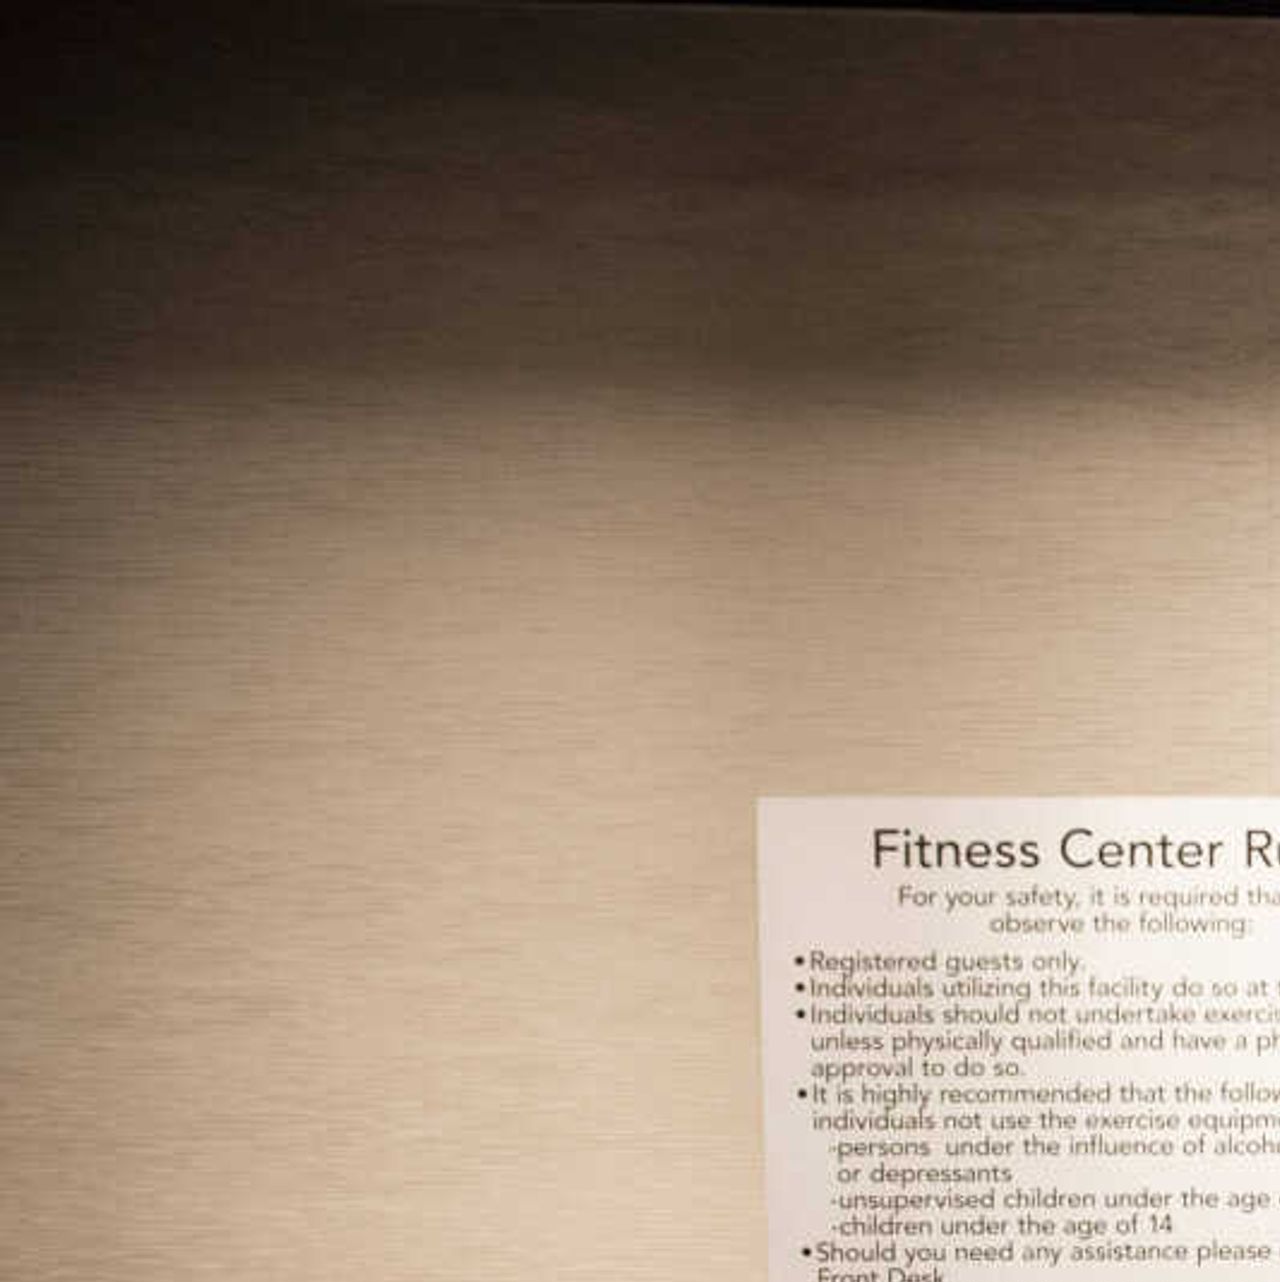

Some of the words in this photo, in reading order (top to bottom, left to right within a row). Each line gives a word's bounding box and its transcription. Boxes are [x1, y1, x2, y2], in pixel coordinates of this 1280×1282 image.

[872, 827, 1042, 868] Fitness
[1059, 827, 1225, 868] Center
[897, 883, 939, 906] For
[943, 890, 999, 911] your
[1005, 883, 1081, 911] safety,
[1089, 883, 1105, 906] it
[1113, 883, 1131, 906] is
[1138, 883, 1240, 911] required
[989, 909, 1085, 932] observe
[1093, 909, 1131, 932] the
[809, 948, 938, 976] Registered
[945, 948, 1024, 976] guests
[808, 974, 935, 998] Individuals
[942, 974, 1032, 1003] utilizing
[1038, 974, 1082, 998] this
[1087, 974, 1164, 1003] facility
[1171, 974, 1204, 998] do
[1211, 981, 1239, 998] so
[1245, 974, 1269, 998] at
[810, 1001, 936, 1024] Individuals
[941, 1001, 1021, 1024] should
[1027, 1001, 1067, 1024] not
[1075, 1001, 1197, 1024] undertake
[810, 1027, 885, 1050] unless
[891, 1027, 1004, 1055] physically
[1009, 1027, 1113, 1055] qualified
[1120, 1027, 1164, 1050] and
[1172, 1027, 1227, 1050] have
[1235, 1034, 1248, 1050] a
[810, 1053, 914, 1081] approval
[921, 1053, 946, 1076] to
[953, 1053, 986, 1076] do
[992, 1060, 1025, 1076] so.
[811, 1080, 829, 1103] It
[835, 1080, 855, 1103] is
[860, 1080, 934, 1108] highly
[938, 1080, 1113, 1103] recommended
[1118, 1080, 1168, 1103] that
[1173, 1080, 1213, 1103] the
[812, 1106, 937, 1129] individuals
[942, 1106, 983, 1129] not
[990, 1113, 1032, 1129] use
[1037, 1106, 1077, 1129] the
[1084, 1106, 1181, 1129] exercise
[828, 1140, 932, 1160] -persons
[945, 1132, 1015, 1155] under
[1022, 1132, 1062, 1155] the
[1068, 1132, 1175, 1155] influence
[1182, 1132, 1205, 1155] of
[836, 1166, 863, 1182] or
[868, 1159, 1014, 1187] depressants
[830, 1185, 996, 1213] -unsupervised
[1002, 1185, 1097, 1208] children
[1103, 1185, 1173, 1208] under
[1180, 1185, 1220, 1208] the
[1225, 1192, 1272, 1213] age
[831, 1211, 934, 1234] -children
[940, 1211, 1010, 1234] under
[1016, 1211, 1057, 1234] the
[1061, 1218, 1108, 1239] age
[1115, 1211, 1139, 1234] of
[1148, 1211, 1173, 1234] 14
[815, 1237, 898, 1261] Should
[903, 1244, 947, 1266] you
[953, 1237, 1015, 1261] need
[1021, 1244, 1063, 1266] any
[1069, 1237, 1190, 1261] assistance
[1196, 1237, 1272, 1266] please
